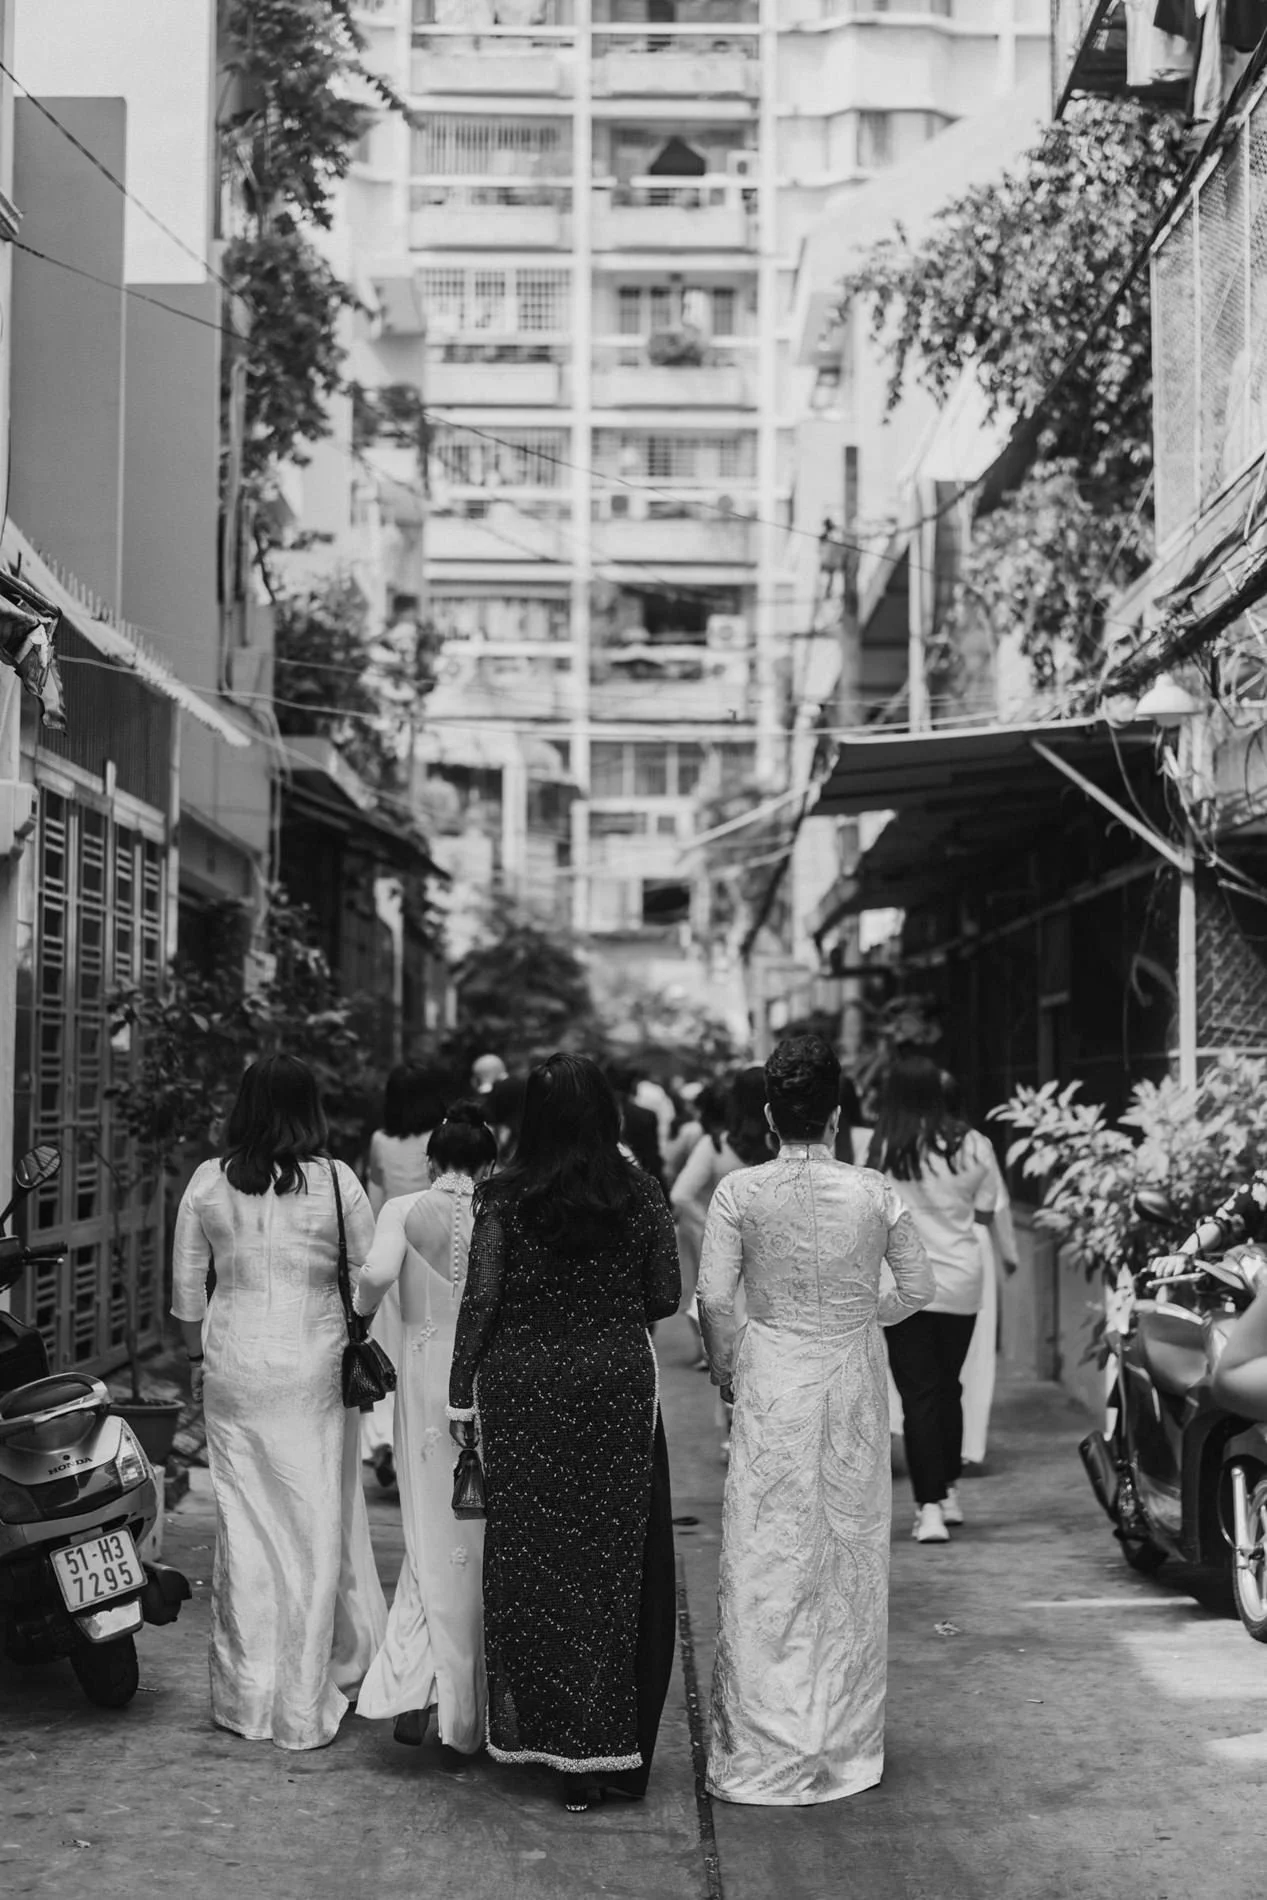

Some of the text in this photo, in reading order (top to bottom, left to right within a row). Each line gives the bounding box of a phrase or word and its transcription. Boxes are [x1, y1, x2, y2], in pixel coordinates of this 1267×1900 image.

[48, 1456, 93, 1475] HONDA
[64, 1535, 125, 1575] 51-H3
[73, 1561, 134, 1603] 7295
